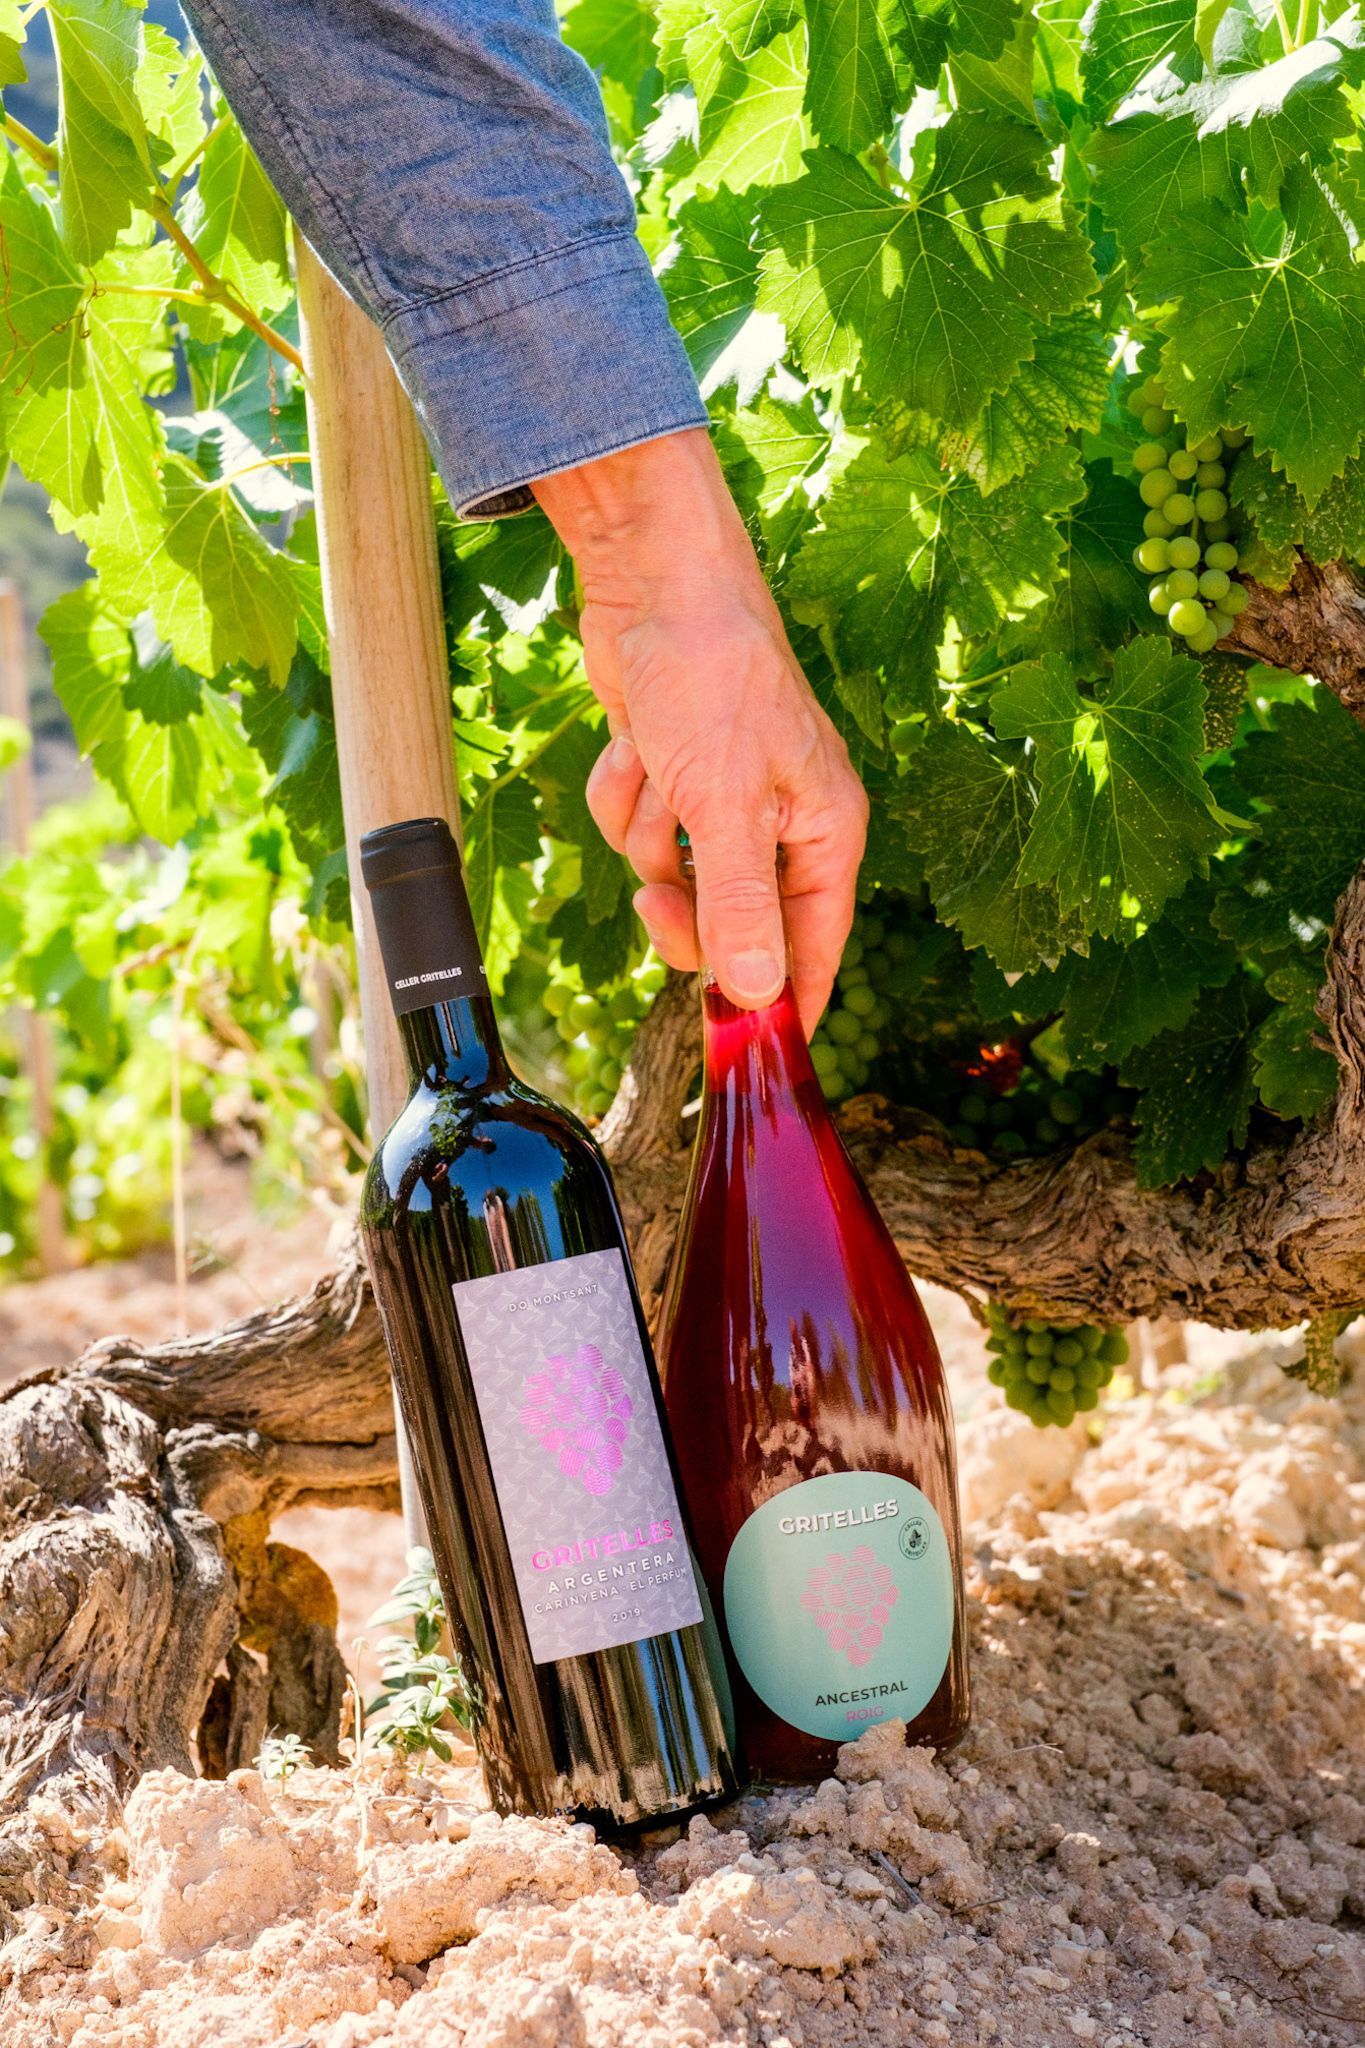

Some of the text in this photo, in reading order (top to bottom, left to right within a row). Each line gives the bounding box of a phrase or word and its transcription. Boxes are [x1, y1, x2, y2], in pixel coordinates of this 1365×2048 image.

[395, 976, 420, 990] CELLER
[420, 966, 463, 983] GRITELLES
[509, 1284, 599, 1312] DO MONTSANT
[779, 1499, 900, 1535] GRITELLES
[531, 1519, 674, 1571] GRITELLES
[548, 1551, 675, 1594] ARGENTERA
[534, 1585, 620, 1614] CARINYENA
[630, 1579, 645, 1592] EL
[611, 1607, 642, 1623] 2019
[814, 1680, 909, 1706] ANCESTRAL
[846, 1705, 885, 1722] ROIG
